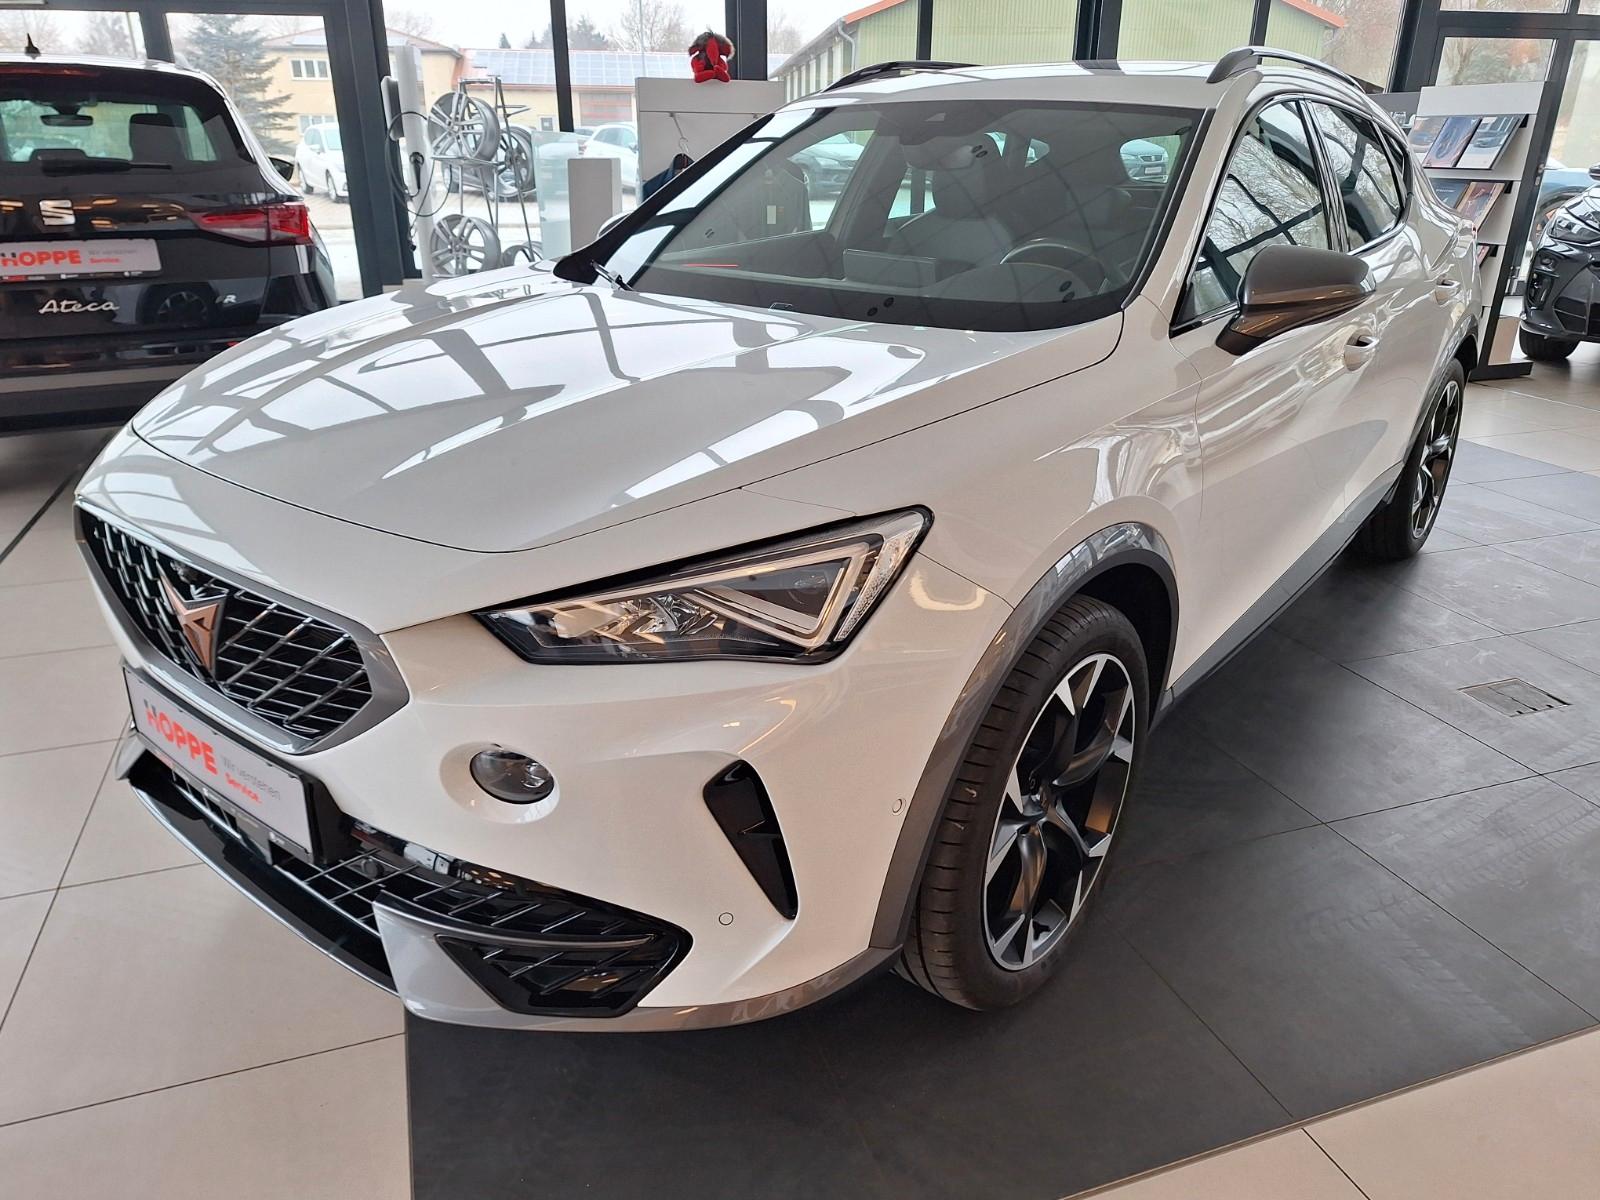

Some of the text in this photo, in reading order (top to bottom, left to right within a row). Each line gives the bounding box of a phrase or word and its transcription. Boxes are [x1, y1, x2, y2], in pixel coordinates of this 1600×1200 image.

[0, 249, 82, 267] HOPPE
[38, 299, 121, 314] Ateca
[143, 699, 219, 776] HOPPE
